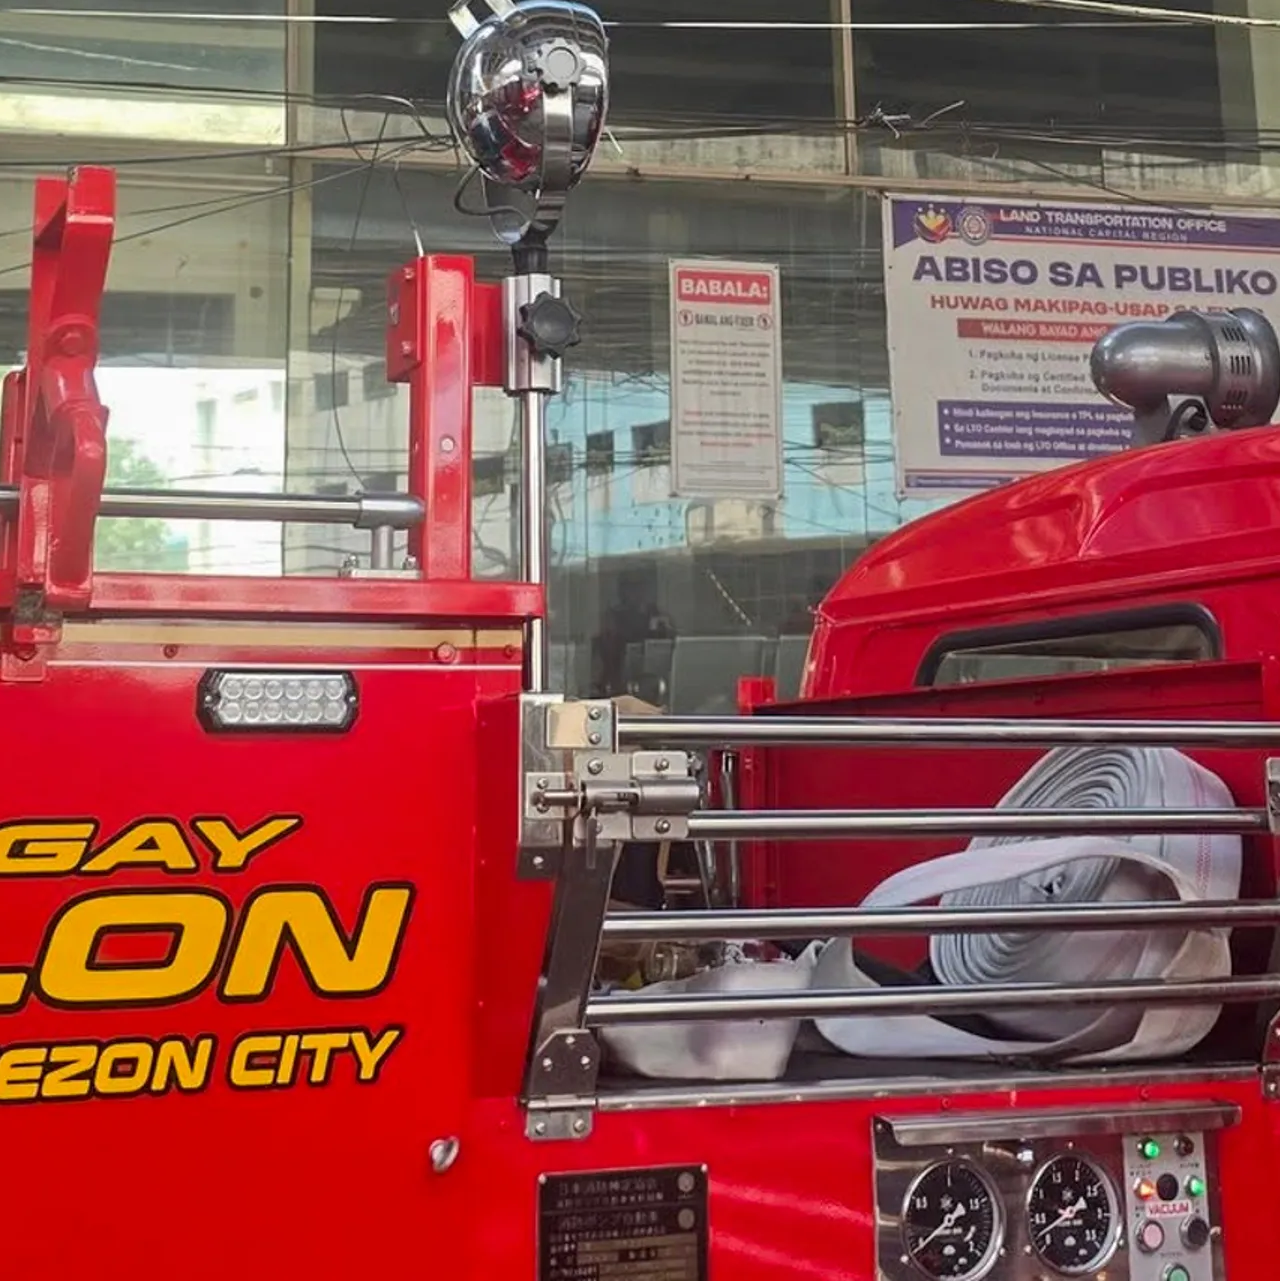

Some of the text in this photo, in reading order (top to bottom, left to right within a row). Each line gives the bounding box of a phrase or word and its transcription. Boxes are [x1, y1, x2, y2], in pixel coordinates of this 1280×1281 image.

[999, 208, 1227, 232] LAND TRANSPORTATION OFFICE
[1025, 225, 1084, 237] NATIONAL
[913, 255, 1278, 296] ABISO SA PUBLIKO
[680, 278, 769, 299] BABALA:
[930, 294, 1009, 311] HUWAG
[1014, 298, 1170, 318] MAKIPAG-USAP
[980, 321, 1037, 337] WALANG
[1038, 323, 1078, 338] BAYAD
[225, 1025, 408, 1092] CITY
